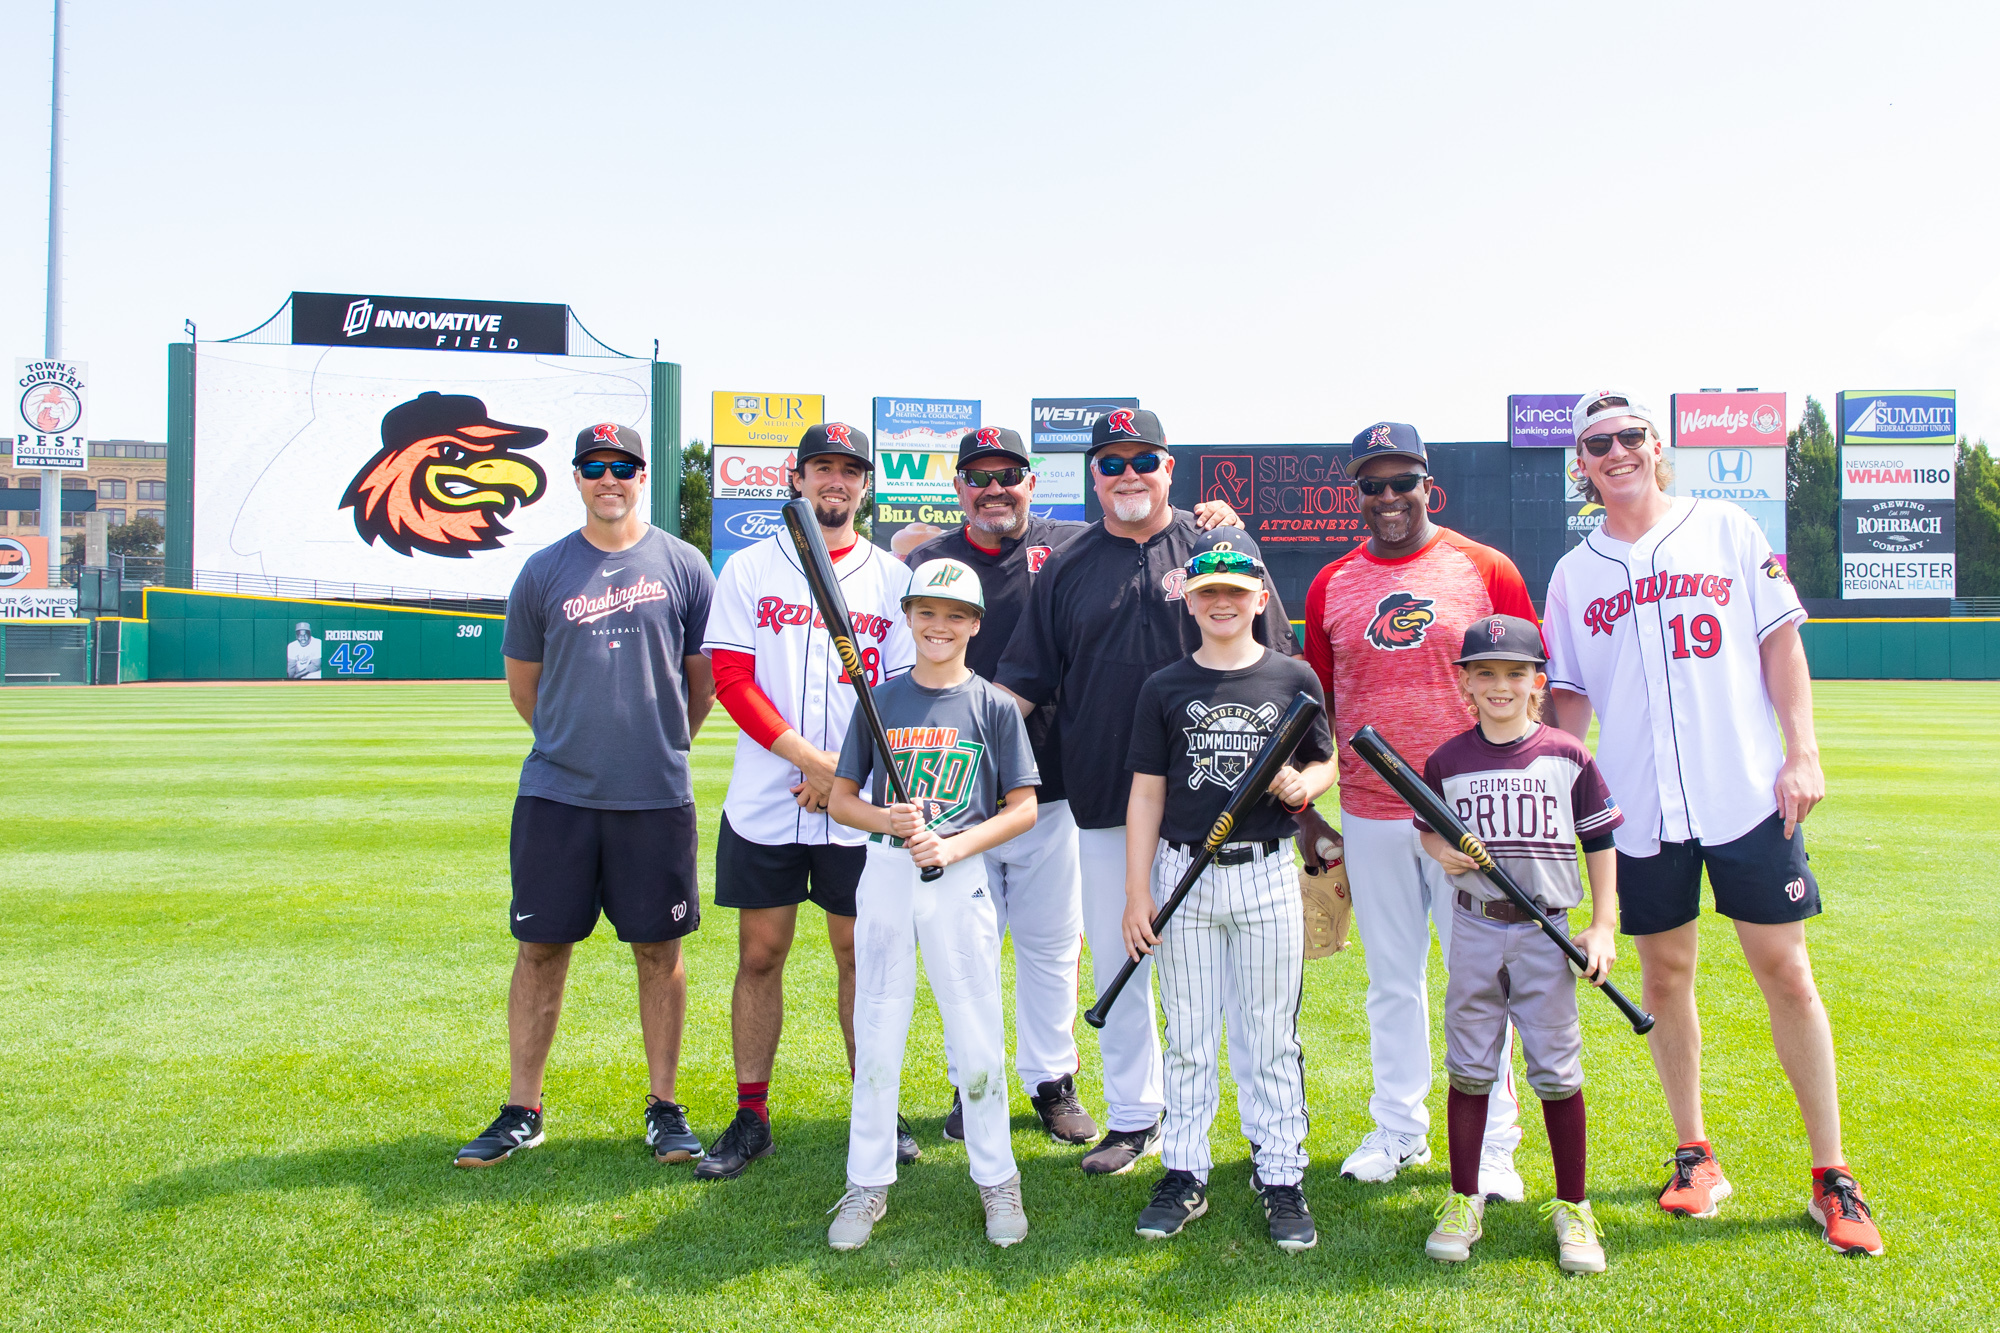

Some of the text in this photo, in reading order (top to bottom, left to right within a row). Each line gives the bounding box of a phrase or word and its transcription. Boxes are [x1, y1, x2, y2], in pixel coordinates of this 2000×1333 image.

[375, 310, 502, 332] INNOVATIVE
[436, 335, 519, 350] FIELD
[26, 362, 76, 375] TOWN &
[19, 371, 85, 390] COUNTRY
[764, 397, 805, 420] UR
[885, 400, 973, 417] JOHN BETLEM
[1034, 407, 1104, 426] WESTH
[1515, 405, 1573, 422] kinect
[1875, 408, 1953, 425] SUMMIT
[1108, 407, 1141, 437] R
[1680, 405, 1749, 434] Wendy's
[593, 422, 624, 448] R
[748, 431, 789, 442] Urology
[826, 423, 856, 452] R
[892, 429, 912, 440] Call
[919, 427, 935, 437] 271
[976, 426, 1004, 449] R
[1366, 423, 1398, 449] R
[1515, 426, 1572, 436] banking done
[17, 435, 84, 448] PEST
[17, 447, 80, 456] SOLUTIONS
[20, 457, 38, 465] PEST
[1259, 454, 1354, 482] SEGA
[1846, 460, 1904, 468] NEWSRADIO
[738, 488, 772, 498] PACKS
[1690, 489, 1770, 498] HONDA
[878, 504, 916, 522] BILL
[1872, 500, 1925, 512] BREWING
[1259, 520, 1359, 530] ATTORNEYS
[1856, 516, 1942, 534] ROHRBACH
[1872, 540, 1924, 552] COMPANY
[1844, 563, 1953, 578] ROCHESTER
[1844, 580, 1953, 590] REGIONAL HEALTH
[562, 574, 668, 626] Washington
[1584, 570, 1733, 637] RED WINGS
[757, 596, 812, 635] RED
[324, 630, 383, 641] ROBINSON
[456, 624, 482, 638] 390
[592, 626, 640, 636] BASEBALL
[1668, 614, 1722, 660] 19
[328, 642, 374, 674] 42
[1200, 708, 1266, 732] VANDERBILT
[886, 727, 959, 750] DIAMOND
[884, 749, 977, 806] PRO
[1470, 778, 1546, 794] CRIMSON
[1456, 793, 1559, 840] PRIDE
[1784, 877, 1805, 902] W
[671, 901, 687, 922] W
